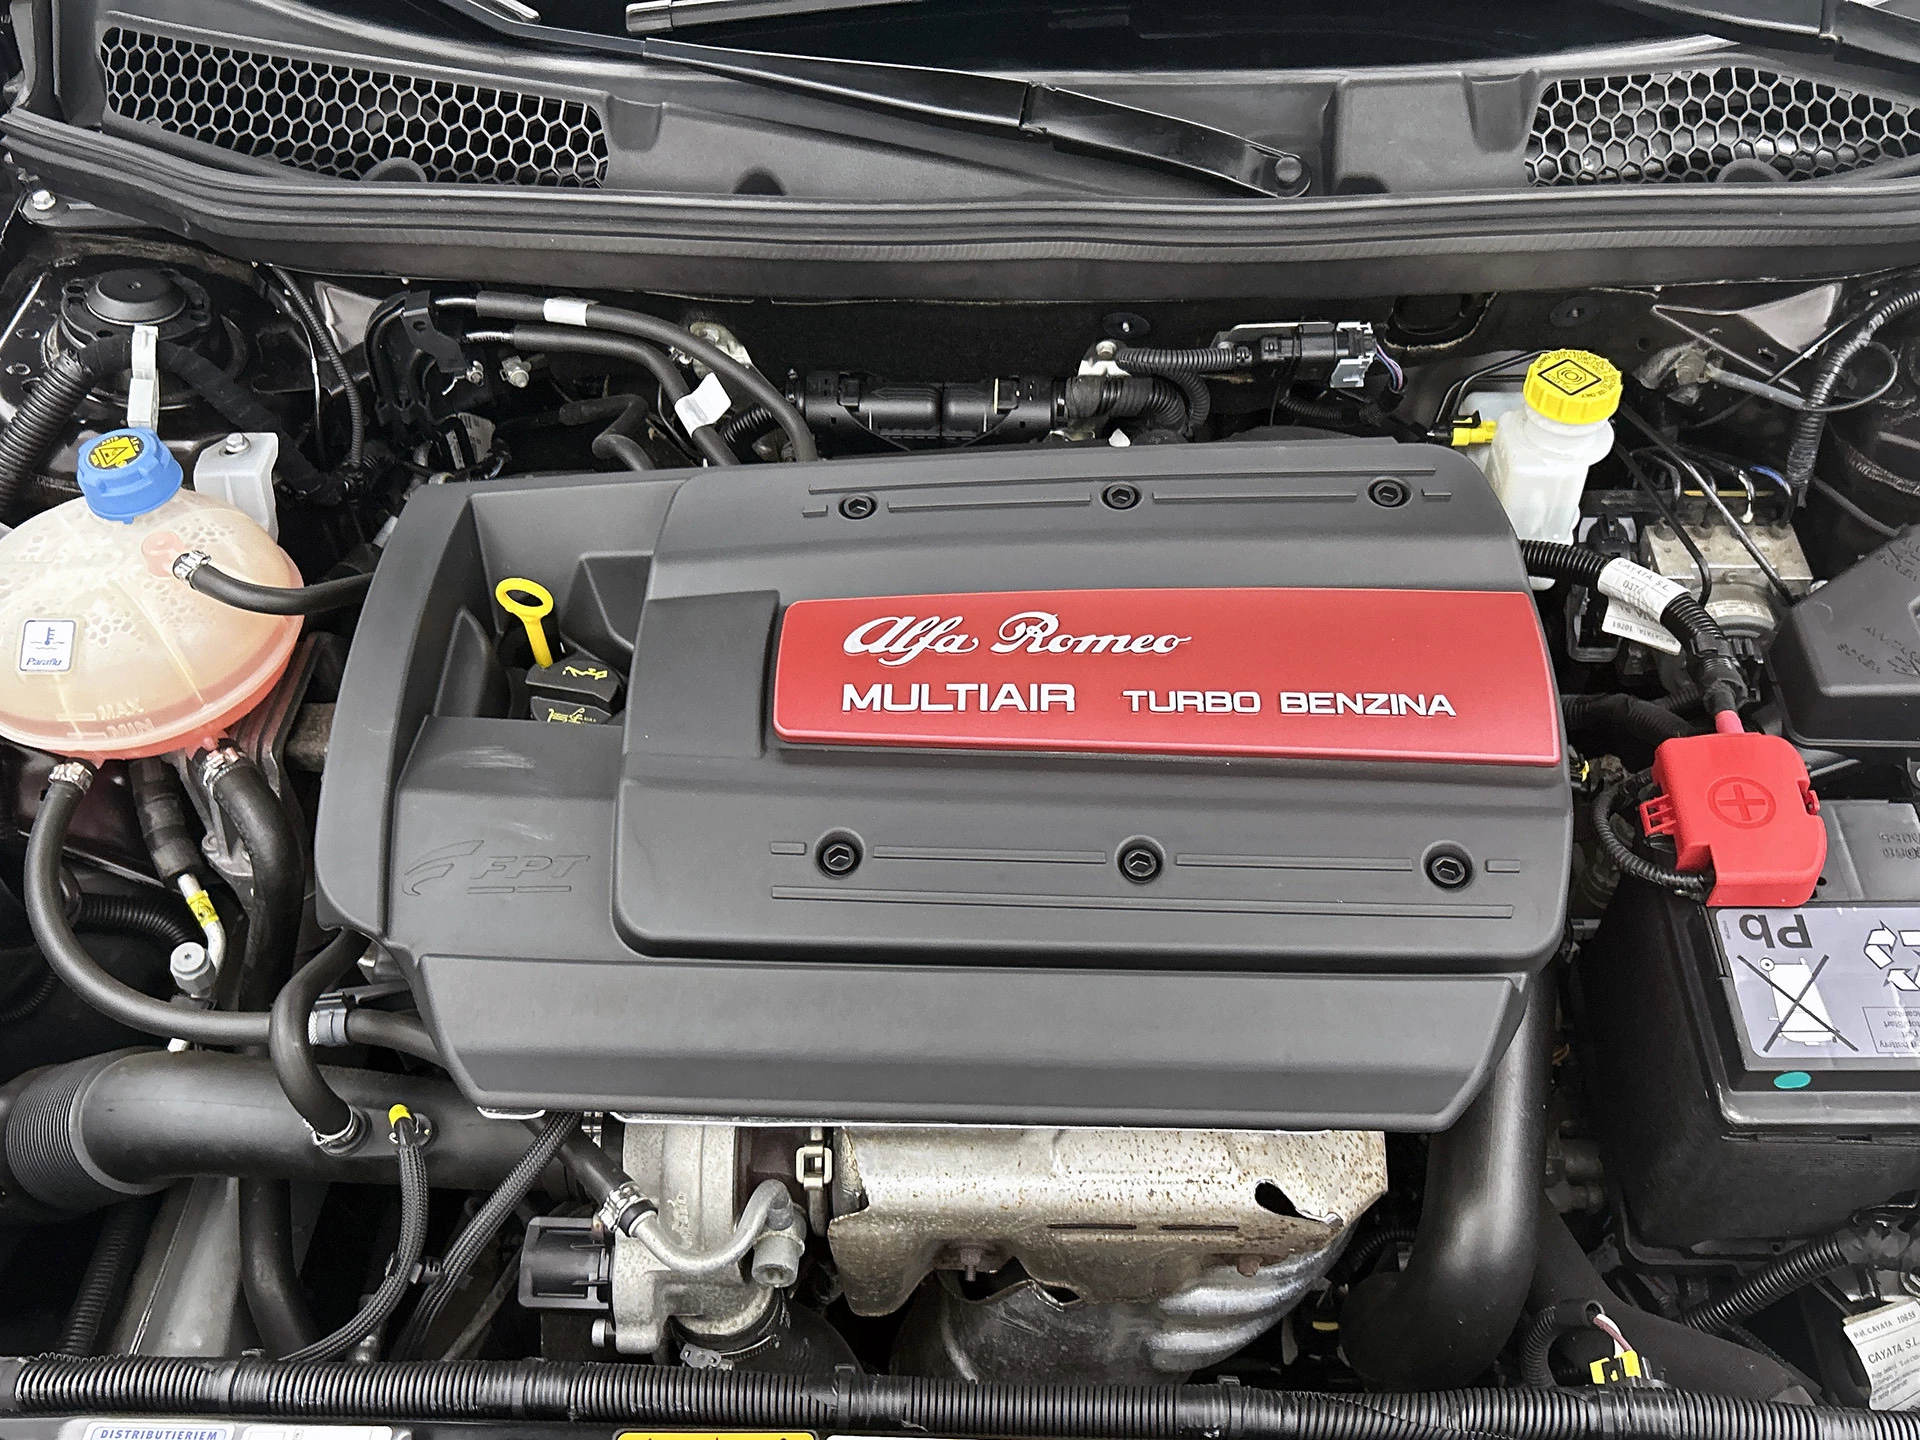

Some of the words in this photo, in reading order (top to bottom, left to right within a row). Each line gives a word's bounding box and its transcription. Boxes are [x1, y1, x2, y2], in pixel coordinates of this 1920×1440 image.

[843, 614, 980, 668] Alfa
[990, 611, 1193, 654] Romeo
[26, 657, 62, 667] Paraflu
[96, 696, 145, 722] MAX
[841, 682, 1077, 713] MULTIAIR
[1121, 689, 1263, 714] TURBO
[1279, 691, 1458, 717] BENZINA
[106, 717, 156, 740] MIN
[470, 854, 592, 880] FPT
[1738, 913, 1813, 949] Pb
[100, 1429, 218, 1440] DISTRIBUTIERIEM
